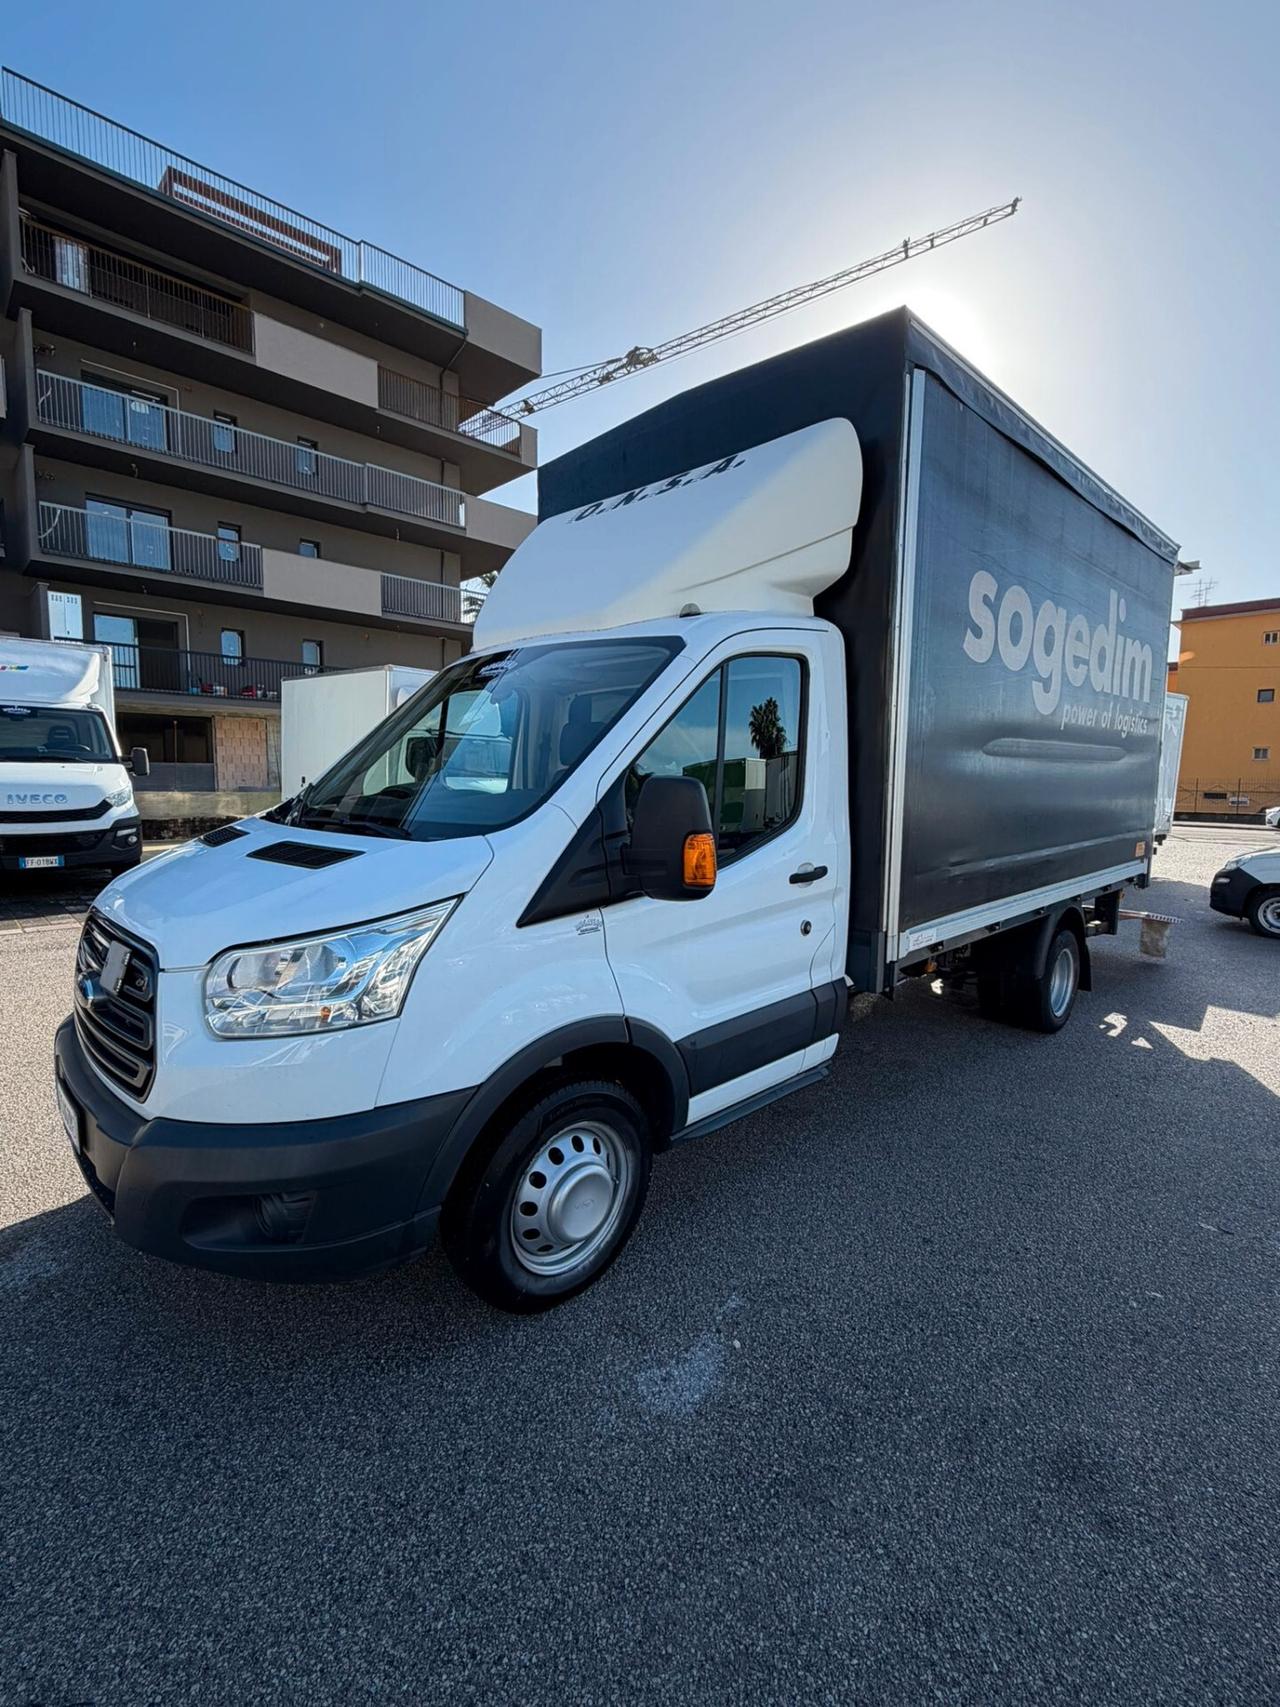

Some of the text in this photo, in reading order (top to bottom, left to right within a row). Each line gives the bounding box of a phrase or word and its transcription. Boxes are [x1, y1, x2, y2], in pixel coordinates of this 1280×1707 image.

[963, 570, 1153, 715] sogedim
[1060, 704, 1097, 730] power
[1101, 701, 1113, 728] of
[1114, 703, 1148, 738] logistics
[7, 793, 68, 805] IVECO
